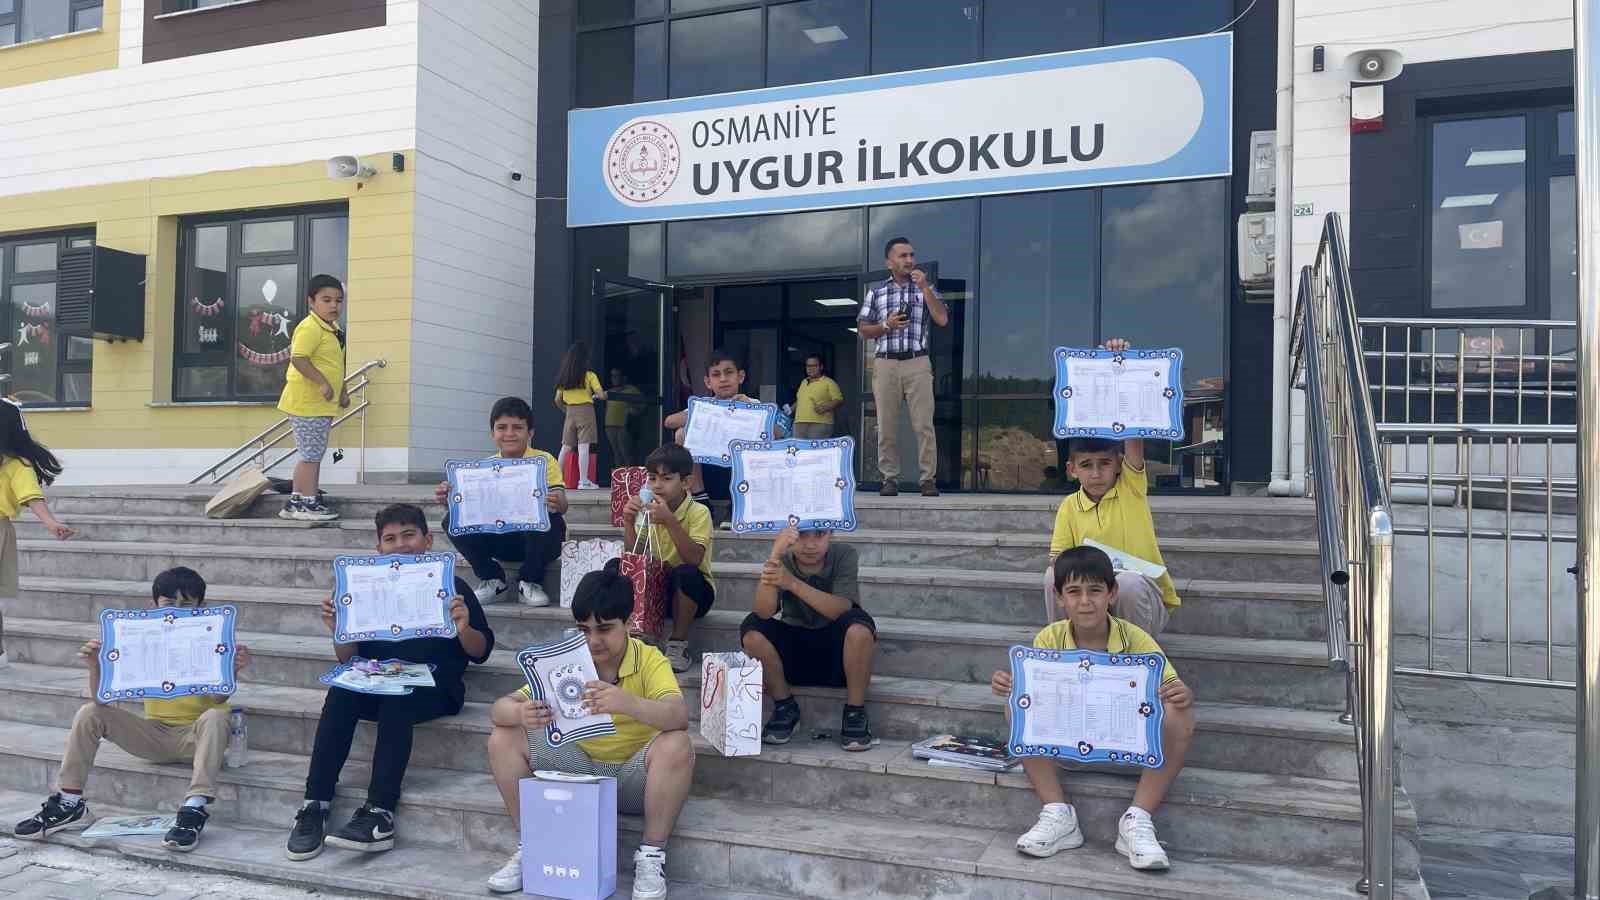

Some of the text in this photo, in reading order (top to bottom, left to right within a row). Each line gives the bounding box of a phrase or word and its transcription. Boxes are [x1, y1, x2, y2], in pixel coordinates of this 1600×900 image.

[692, 105, 836, 148] OSMANİYE
[693, 150, 844, 196] UYGUR
[857, 123, 1105, 182] İLKOKULU
